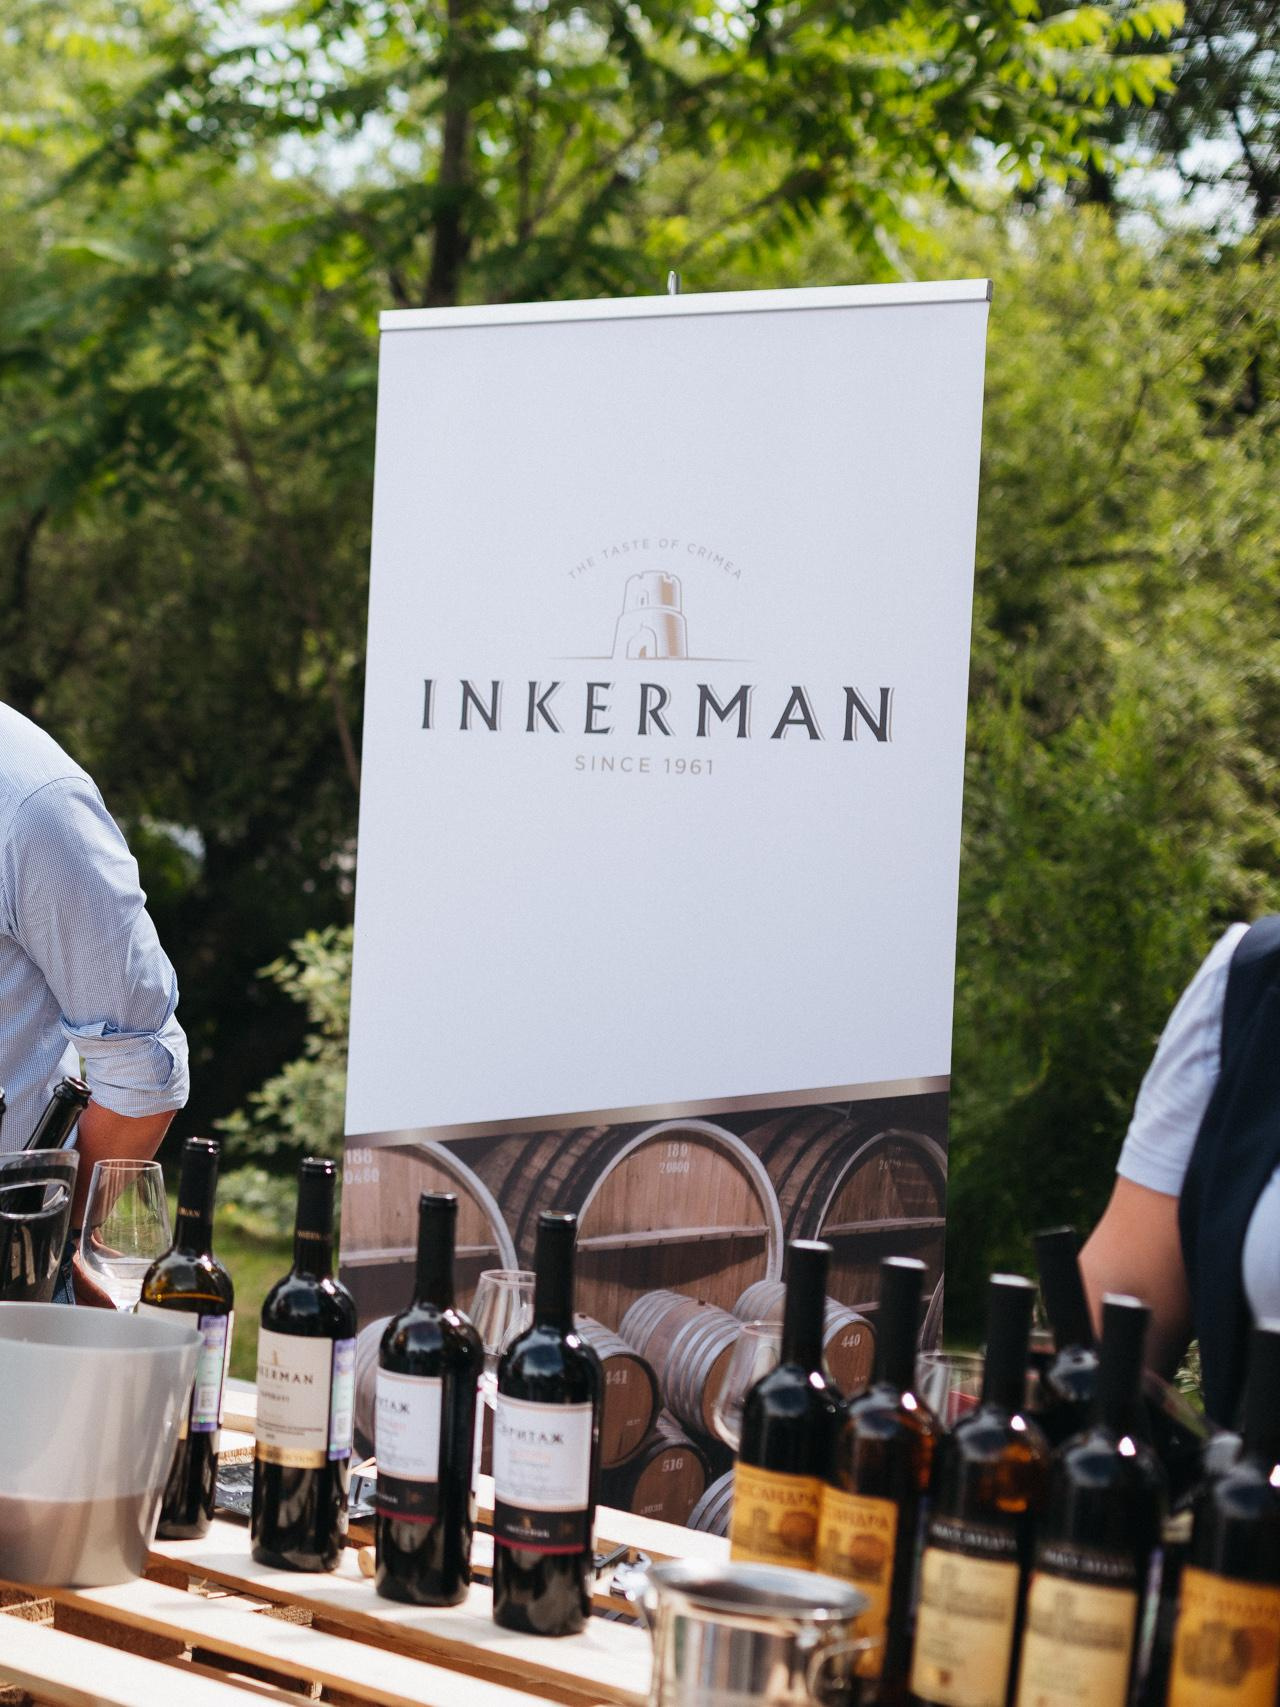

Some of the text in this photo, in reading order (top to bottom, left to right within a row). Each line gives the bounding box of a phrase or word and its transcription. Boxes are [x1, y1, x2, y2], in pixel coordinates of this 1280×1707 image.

[568, 538, 743, 581] THE TASTE OF CRIMEA
[421, 678, 895, 743] INKERMAN
[575, 755, 713, 776] SINCE 1961
[841, 1334, 861, 1348] 440
[661, 1457, 684, 1472] 516
